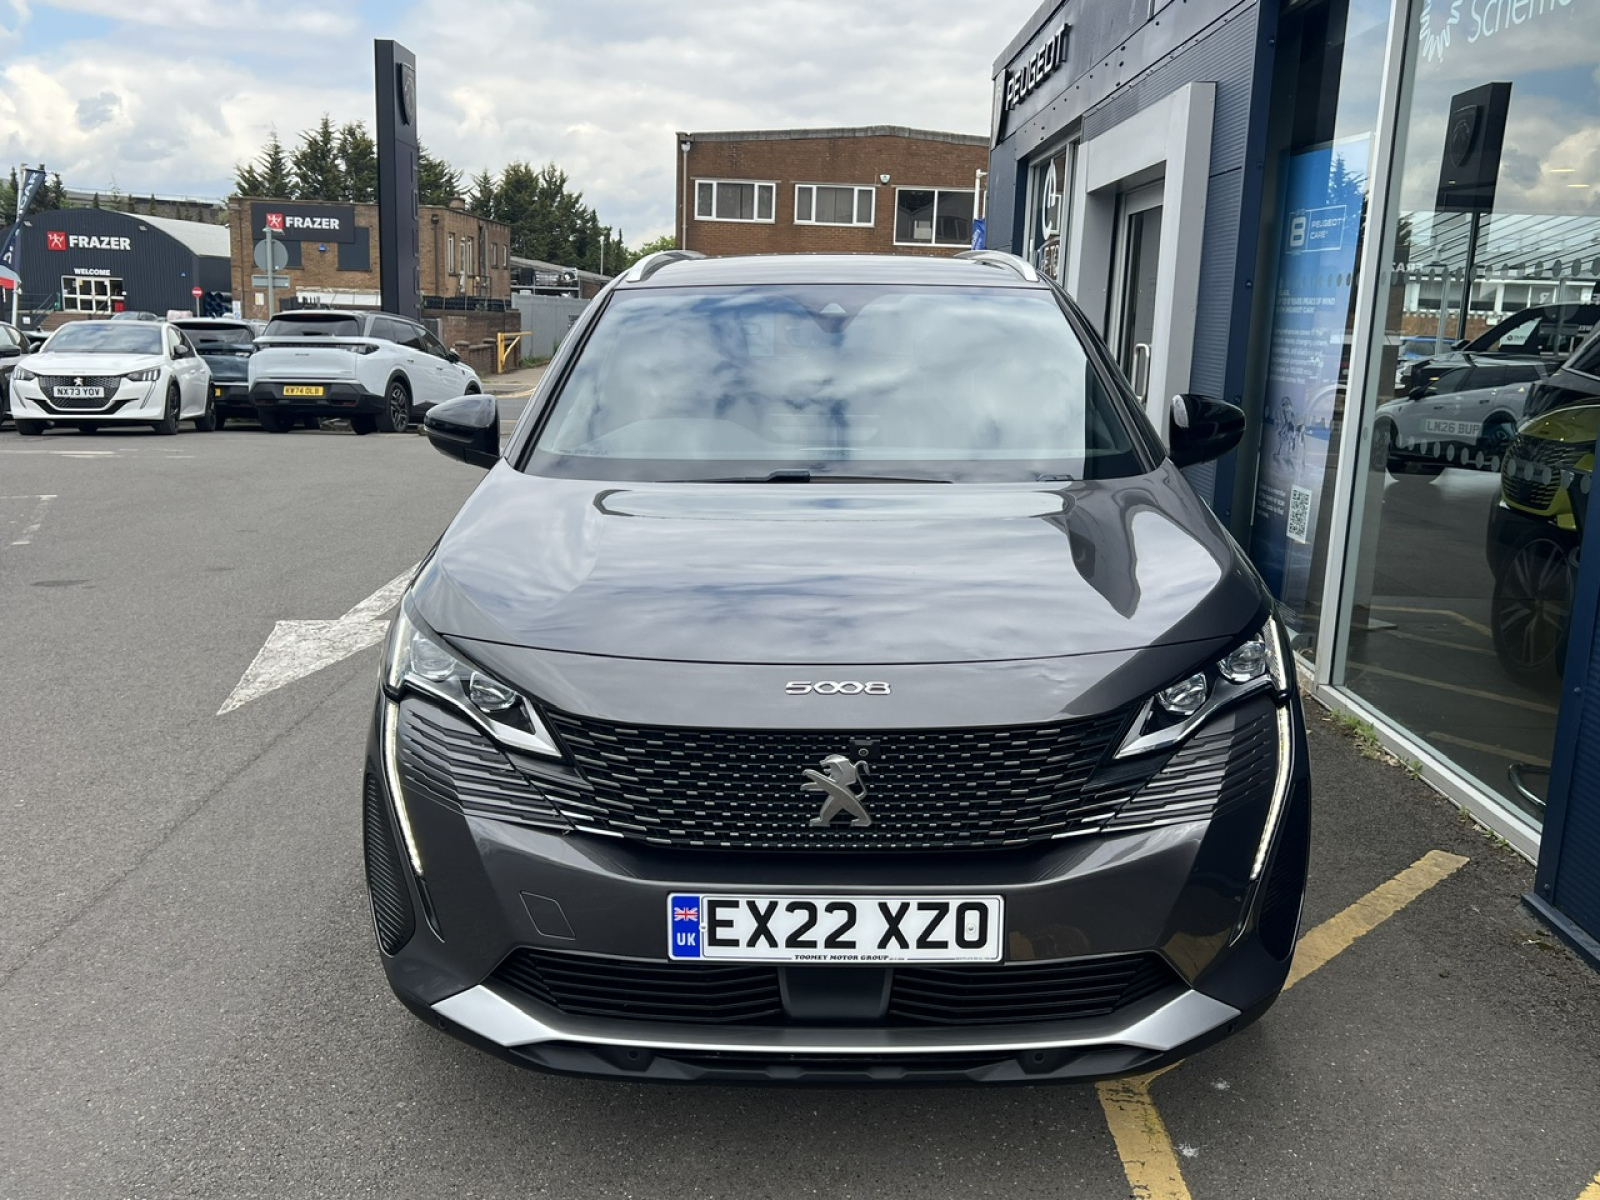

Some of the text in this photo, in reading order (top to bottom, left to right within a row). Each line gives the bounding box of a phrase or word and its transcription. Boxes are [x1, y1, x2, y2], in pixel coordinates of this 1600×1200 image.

[1004, 23, 1072, 111] PEUGEOT
[285, 216, 340, 230] FRAZER
[69, 235, 131, 250] FRAZER
[74, 268, 111, 276] WELCOME
[785, 680, 892, 696] 5008
[707, 899, 857, 949] EX22
[676, 933, 696, 946] UK
